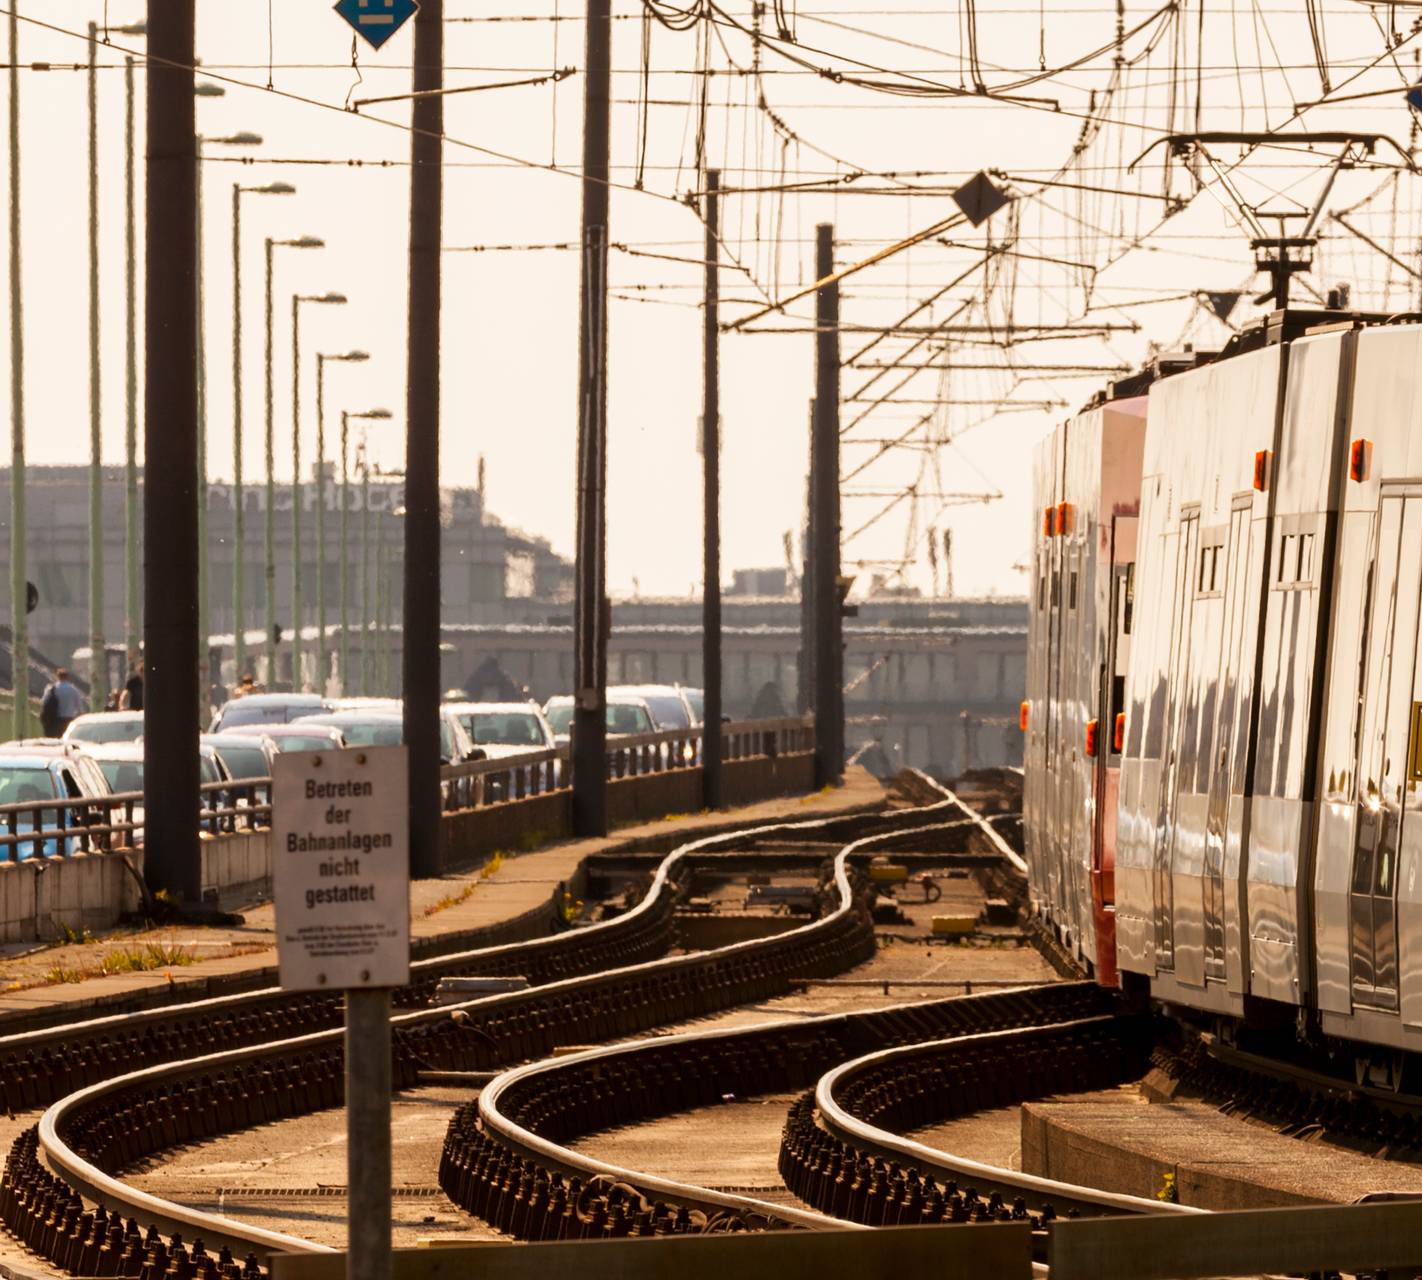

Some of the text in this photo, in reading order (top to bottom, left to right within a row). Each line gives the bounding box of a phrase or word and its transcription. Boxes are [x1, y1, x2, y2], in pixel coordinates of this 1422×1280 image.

[305, 779, 372, 799] Betreten
[325, 806, 351, 824] der
[287, 833, 392, 853] Bahnanlagen
[320, 857, 360, 877] nicht
[306, 885, 375, 908] gestattet
